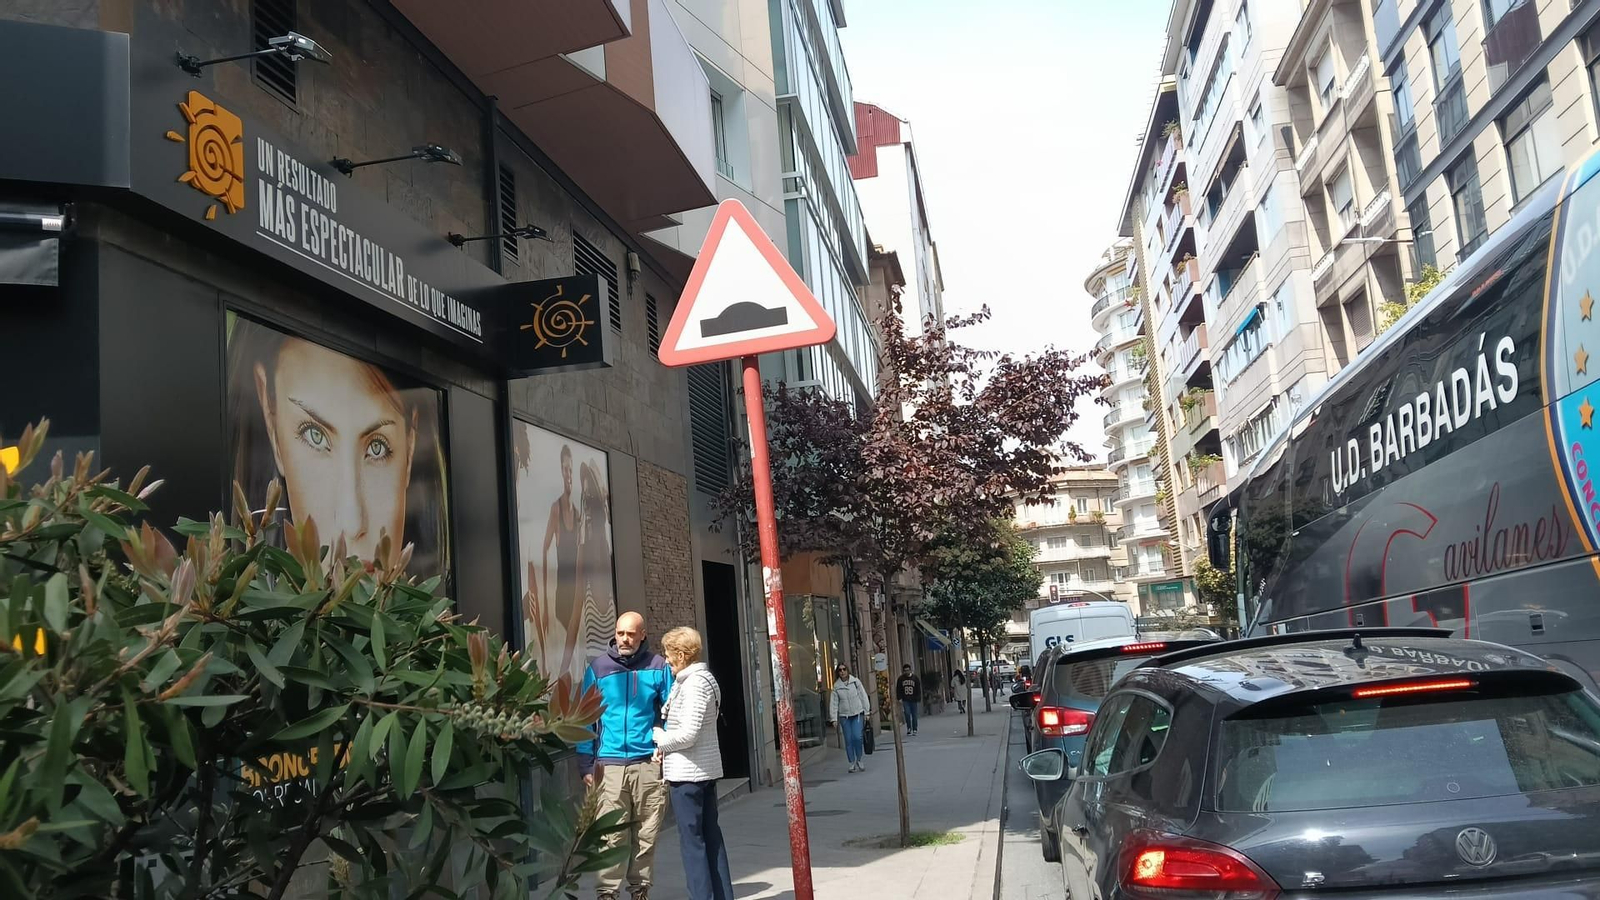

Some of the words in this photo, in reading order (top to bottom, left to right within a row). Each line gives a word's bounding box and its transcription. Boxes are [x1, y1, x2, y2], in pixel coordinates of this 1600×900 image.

[257, 136, 273, 177] UN
[277, 149, 337, 213] RESULTADO
[259, 178, 296, 243] MÁS
[301, 202, 405, 299] ESPECTACULAR
[407, 274, 419, 305] DE
[420, 281, 430, 310] LO
[431, 287, 447, 319] QUE
[447, 295, 482, 336] IMAGINAS
[1331, 437, 1367, 493] U.D.
[1370, 332, 1519, 473] BARBADÁS
[1572, 441, 1600, 537] CONC
